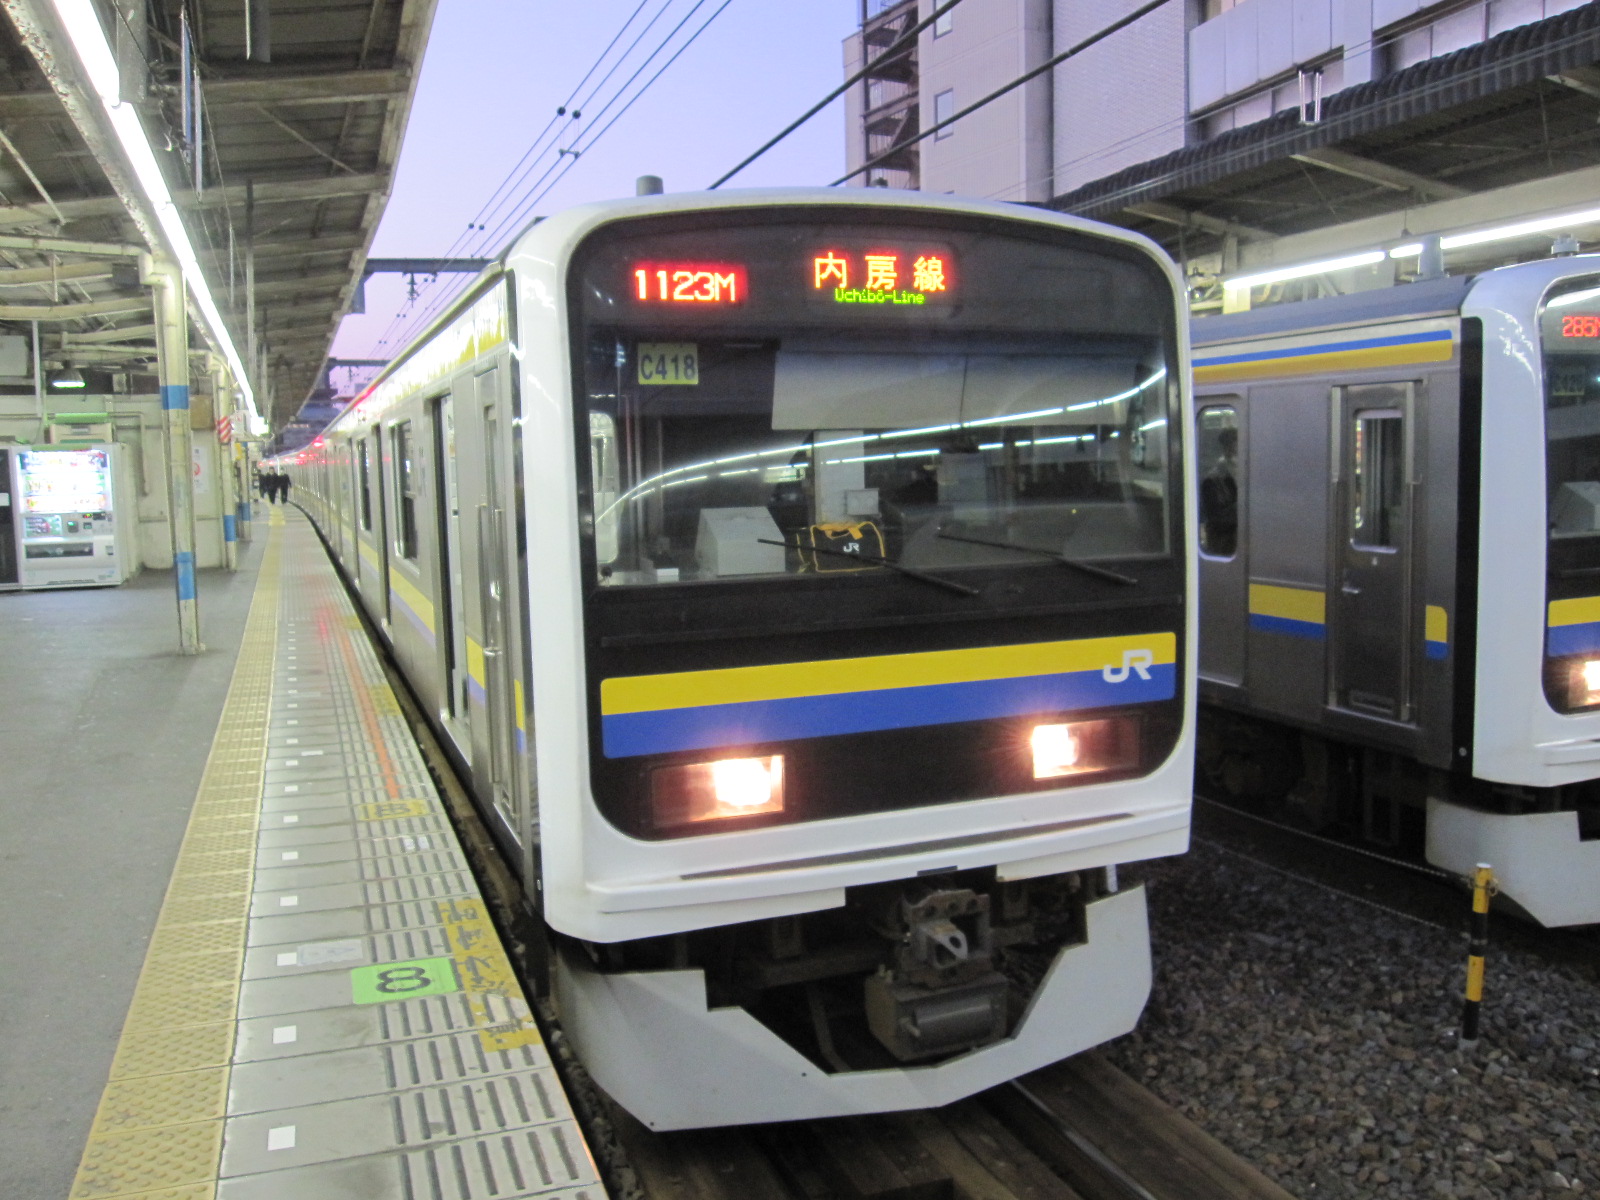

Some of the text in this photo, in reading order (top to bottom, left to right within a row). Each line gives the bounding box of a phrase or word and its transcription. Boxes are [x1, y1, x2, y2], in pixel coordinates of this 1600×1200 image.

[634, 270, 736, 301] 1123M
[813, 252, 945, 291] 内房線
[640, 354, 696, 381] C418
[843, 542, 860, 553] JR
[1103, 649, 1153, 683] JR
[375, 966, 431, 994] 8
